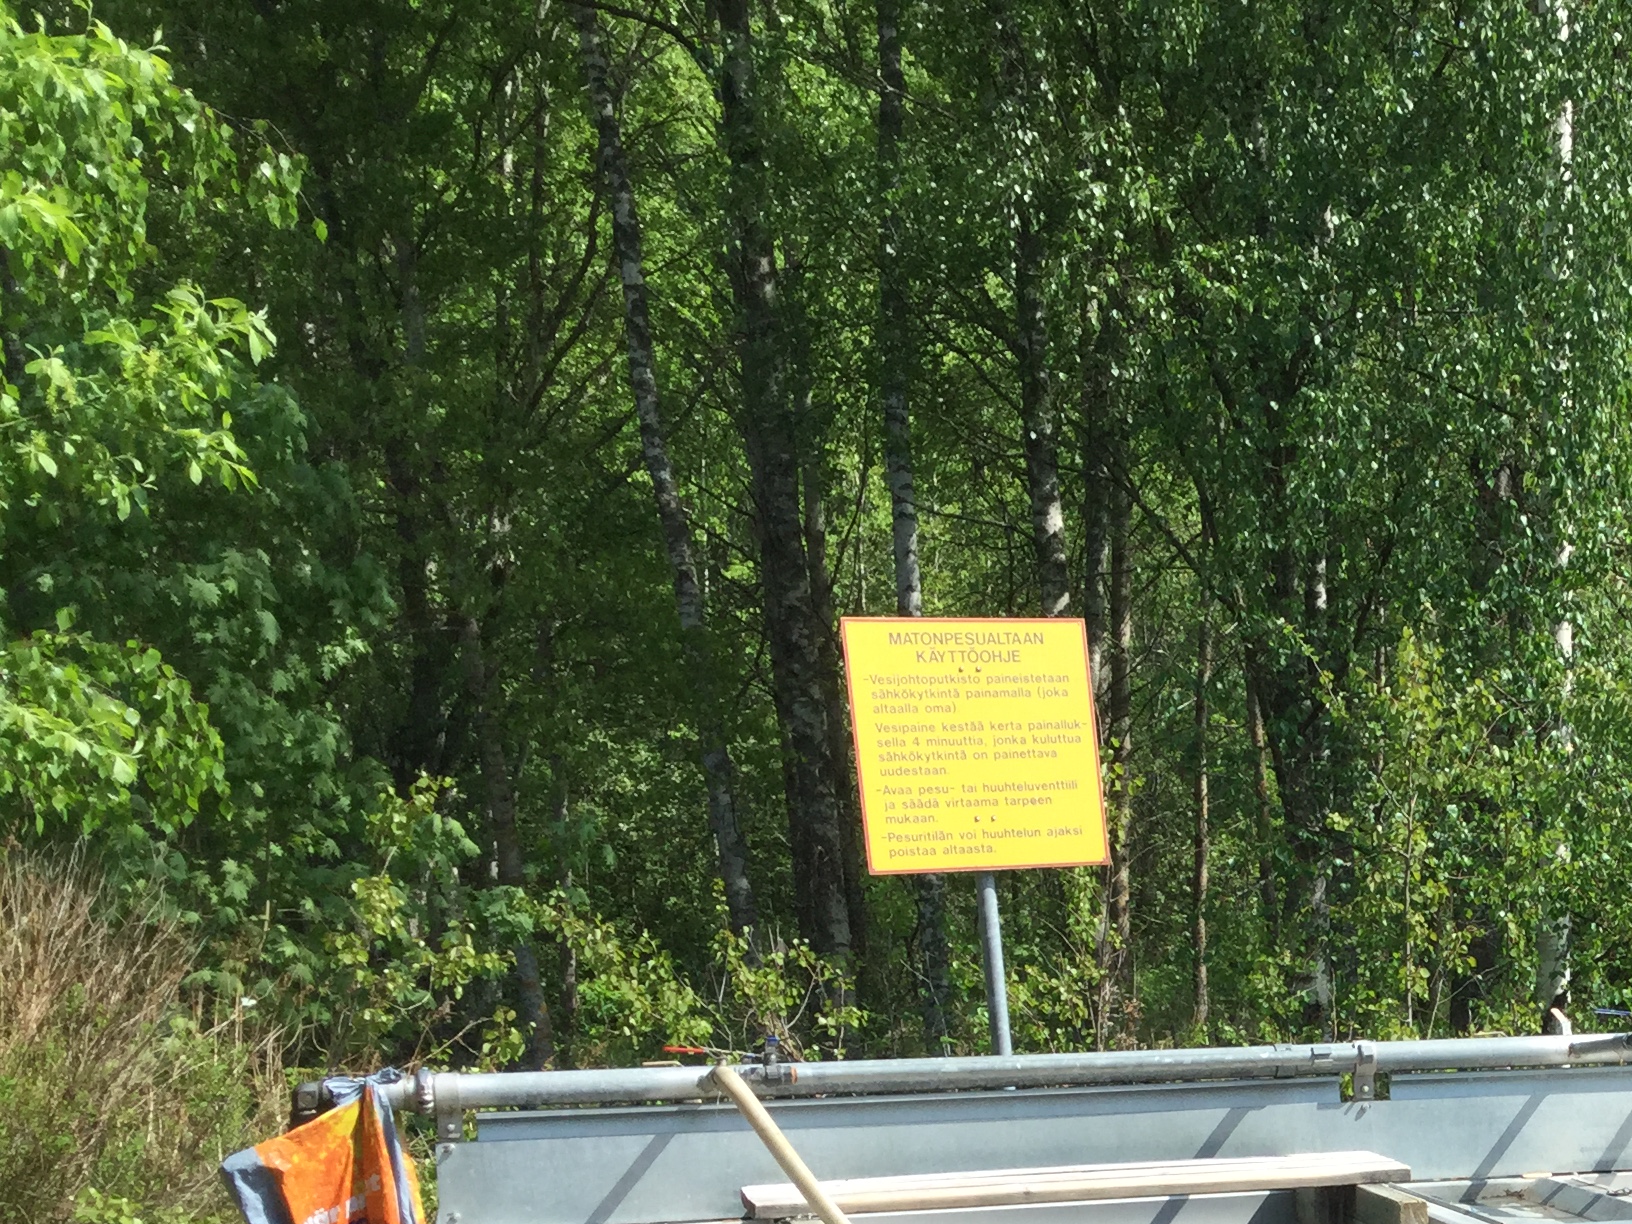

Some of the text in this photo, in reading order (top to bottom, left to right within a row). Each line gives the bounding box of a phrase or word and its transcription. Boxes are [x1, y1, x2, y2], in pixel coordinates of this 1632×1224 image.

[888, 632, 1045, 646] MATONPESUALTAAN
[915, 647, 1022, 664] KÄYTTÖOHJE
[985, 673, 1070, 686] paineistetaan
[870, 686, 1069, 702] sähkökytkintä painamalla (joka
[872, 703, 919, 715] altaalla
[874, 719, 1088, 735] Vesipaine kestää kerta painalluk-
[876, 737, 907, 749] sella
[911, 737, 921, 747] 4
[992, 735, 1027, 748] jonka
[1031, 734, 1082, 745] kuluttua
[877, 749, 1058, 764] sähkökytkintä on painettava
[917, 786, 955, 797] pesu-
[961, 784, 978, 794] tai
[982, 780, 1079, 793] huuhteluventtiili
[884, 797, 1053, 813] ja säädä virtaama tarpeen
[884, 814, 939, 825] mukaan.
[958, 830, 977, 841] voi
[981, 828, 1042, 840] huuhtelun
[1046, 826, 1083, 839] ajaksi
[888, 844, 997, 860] poistaa altaasta.
